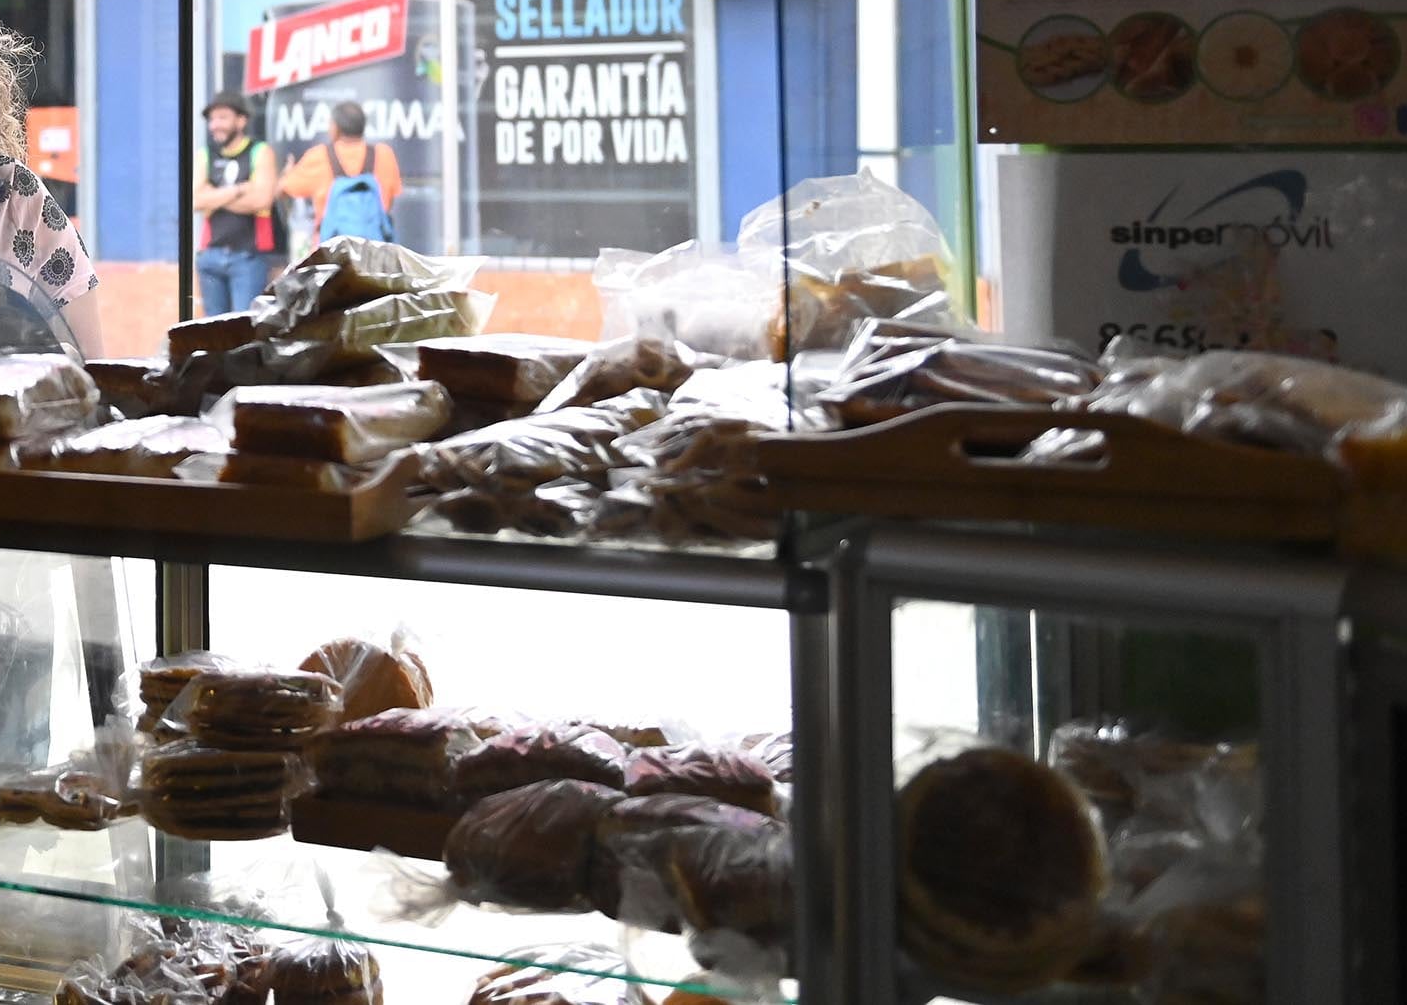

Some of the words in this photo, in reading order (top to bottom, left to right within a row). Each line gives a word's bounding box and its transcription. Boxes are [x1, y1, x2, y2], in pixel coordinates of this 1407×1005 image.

[259, 5, 391, 87] LANCO
[494, 52, 688, 119] GARANTÍA
[496, 121, 536, 166] DE
[543, 119, 602, 165] POR
[611, 117, 688, 165] VIDA
